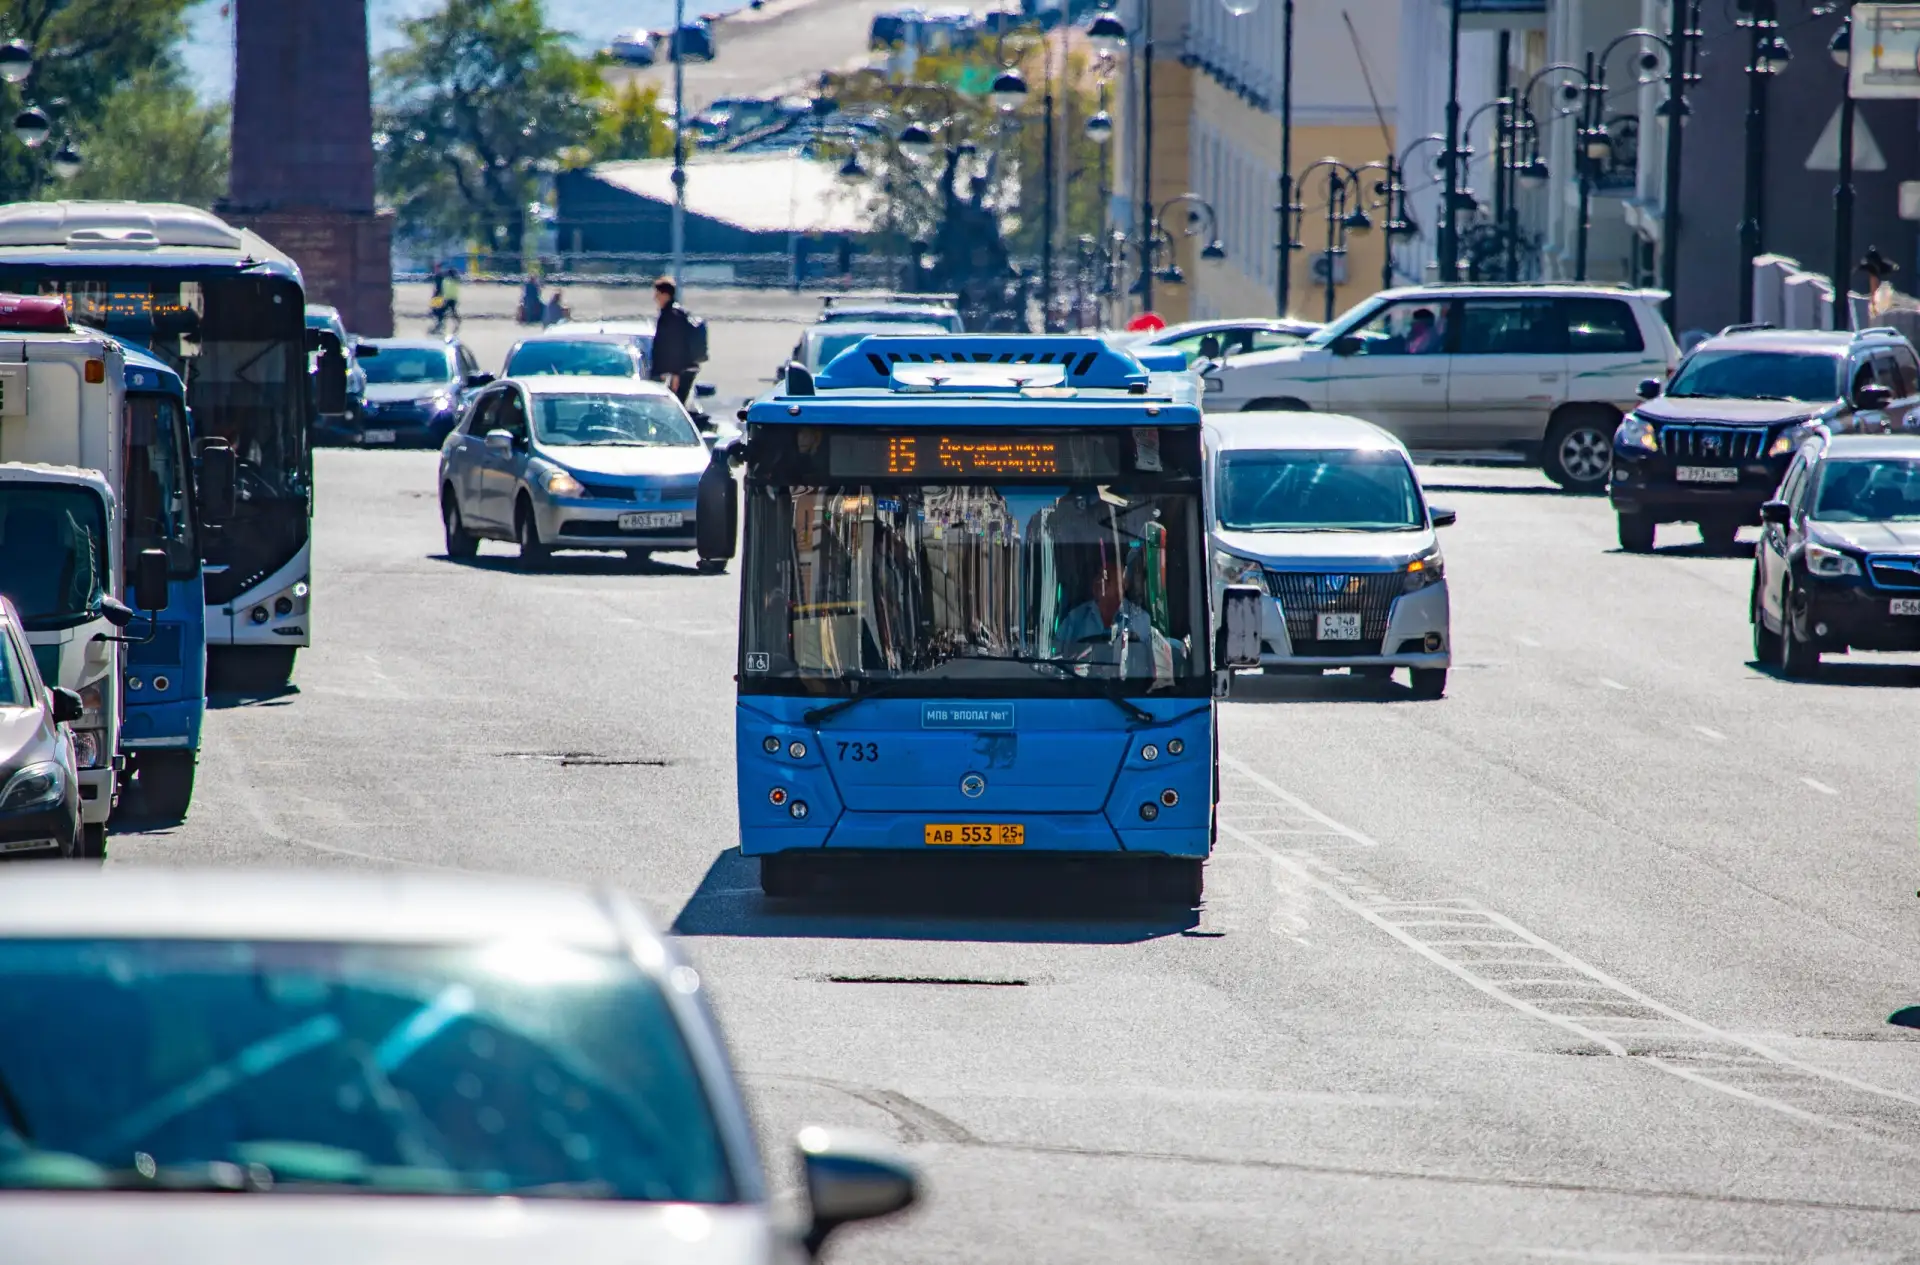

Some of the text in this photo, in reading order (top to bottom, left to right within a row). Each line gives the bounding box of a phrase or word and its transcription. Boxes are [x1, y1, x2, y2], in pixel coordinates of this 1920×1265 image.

[889, 438, 915, 472] 15
[927, 710, 948, 720] МПВ
[836, 742, 878, 762] 733
[961, 827, 992, 842] 553
[1002, 826, 1018, 838] 25
